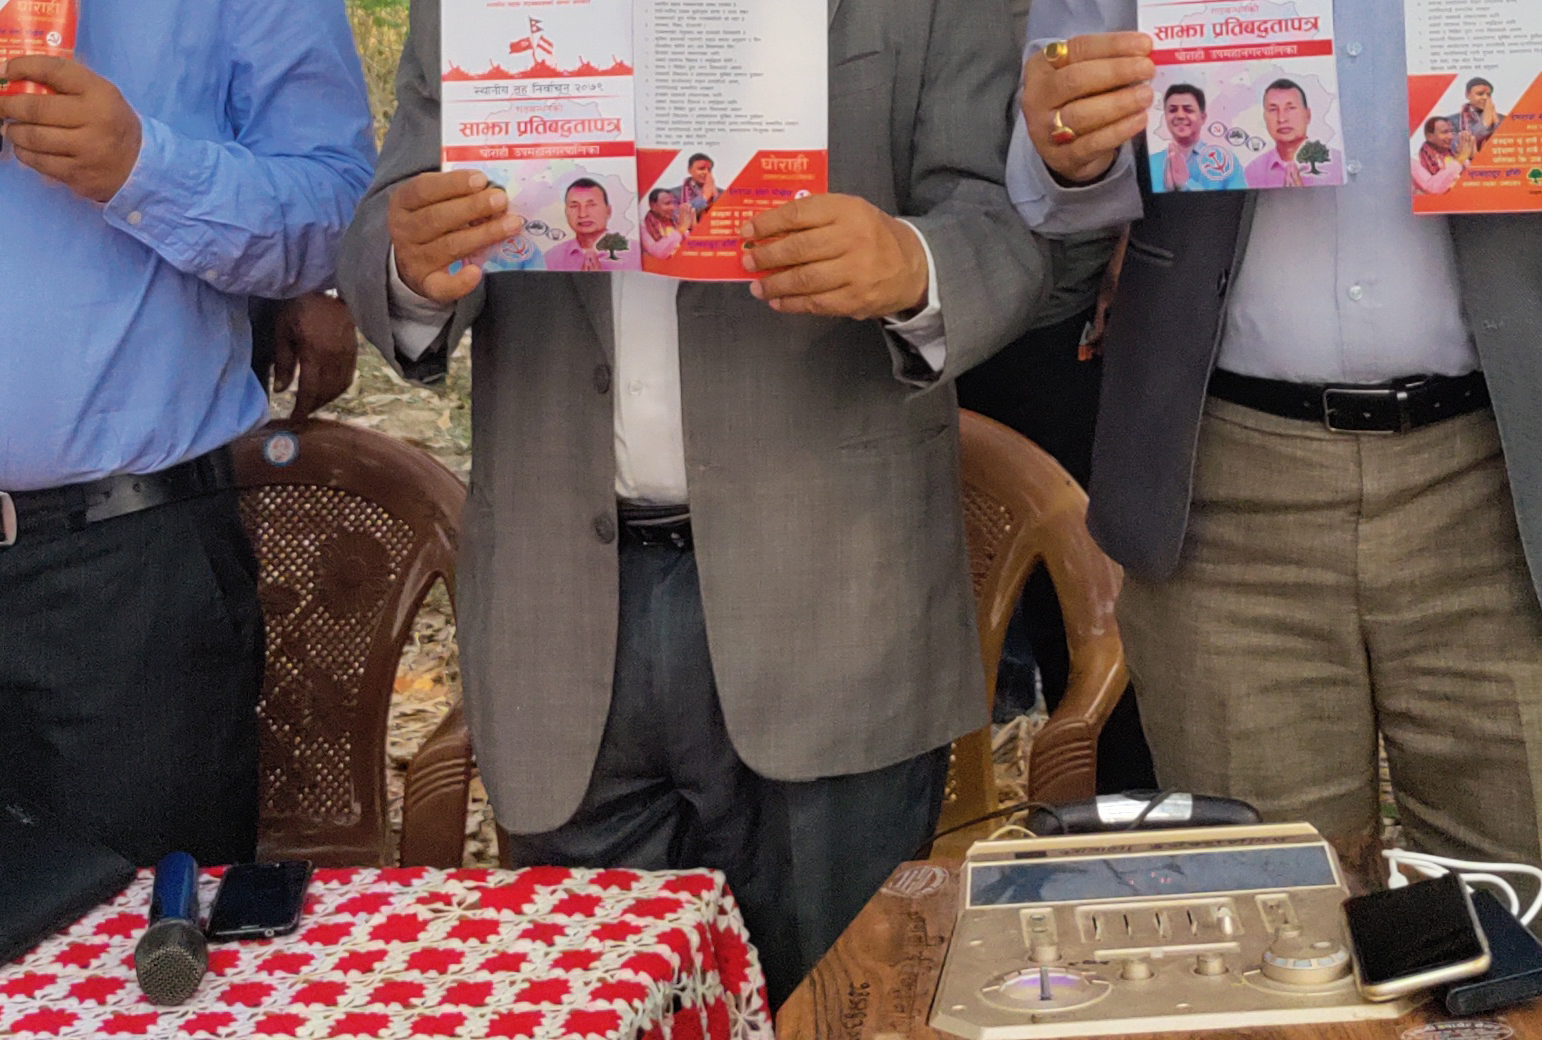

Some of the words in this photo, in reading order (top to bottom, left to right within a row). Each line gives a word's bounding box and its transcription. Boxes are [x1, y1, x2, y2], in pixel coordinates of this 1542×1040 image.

[1154, 23, 1206, 41] साझा
[459, 121, 511, 137] साझा
[760, 153, 809, 172] घोराही
